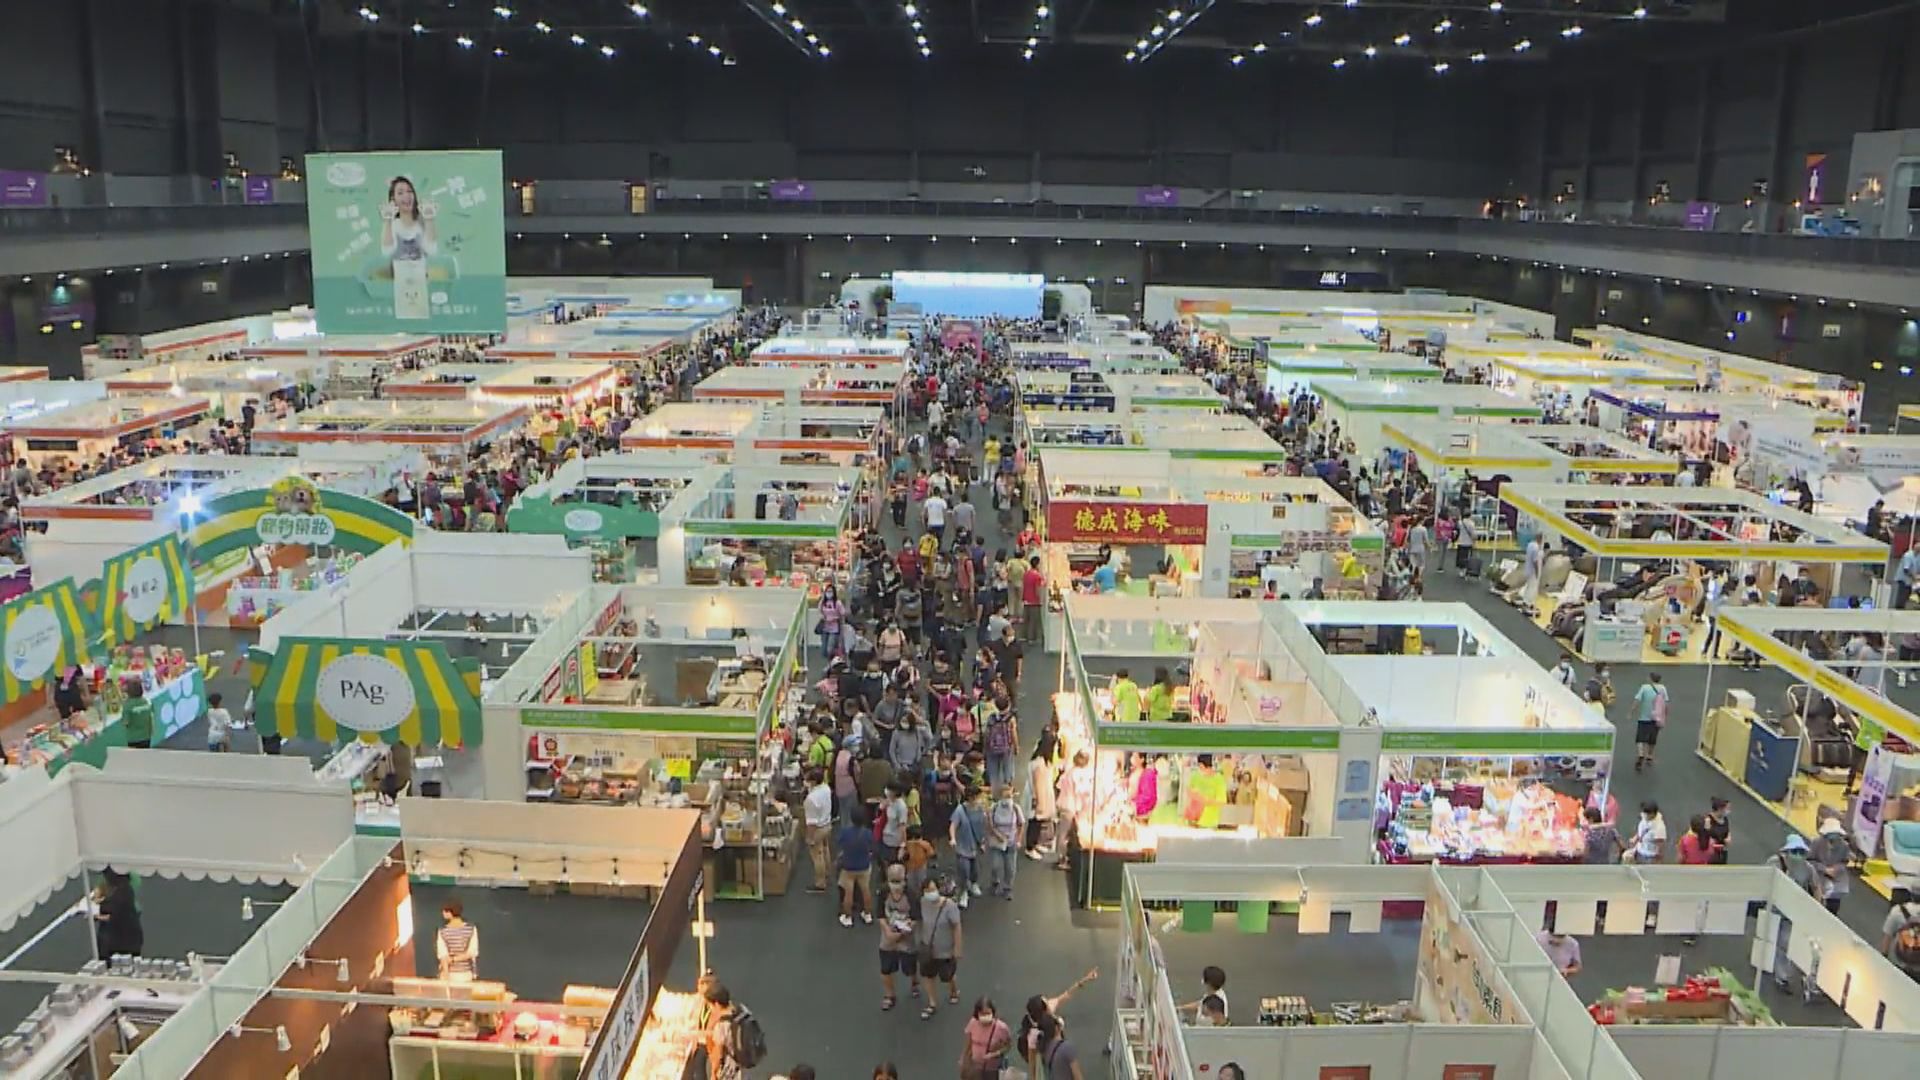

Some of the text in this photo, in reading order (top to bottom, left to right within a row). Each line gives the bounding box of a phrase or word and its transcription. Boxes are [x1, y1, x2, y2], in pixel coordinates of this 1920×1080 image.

[1074, 507, 1171, 533] 德成海味
[340, 679, 385, 705] PAg
